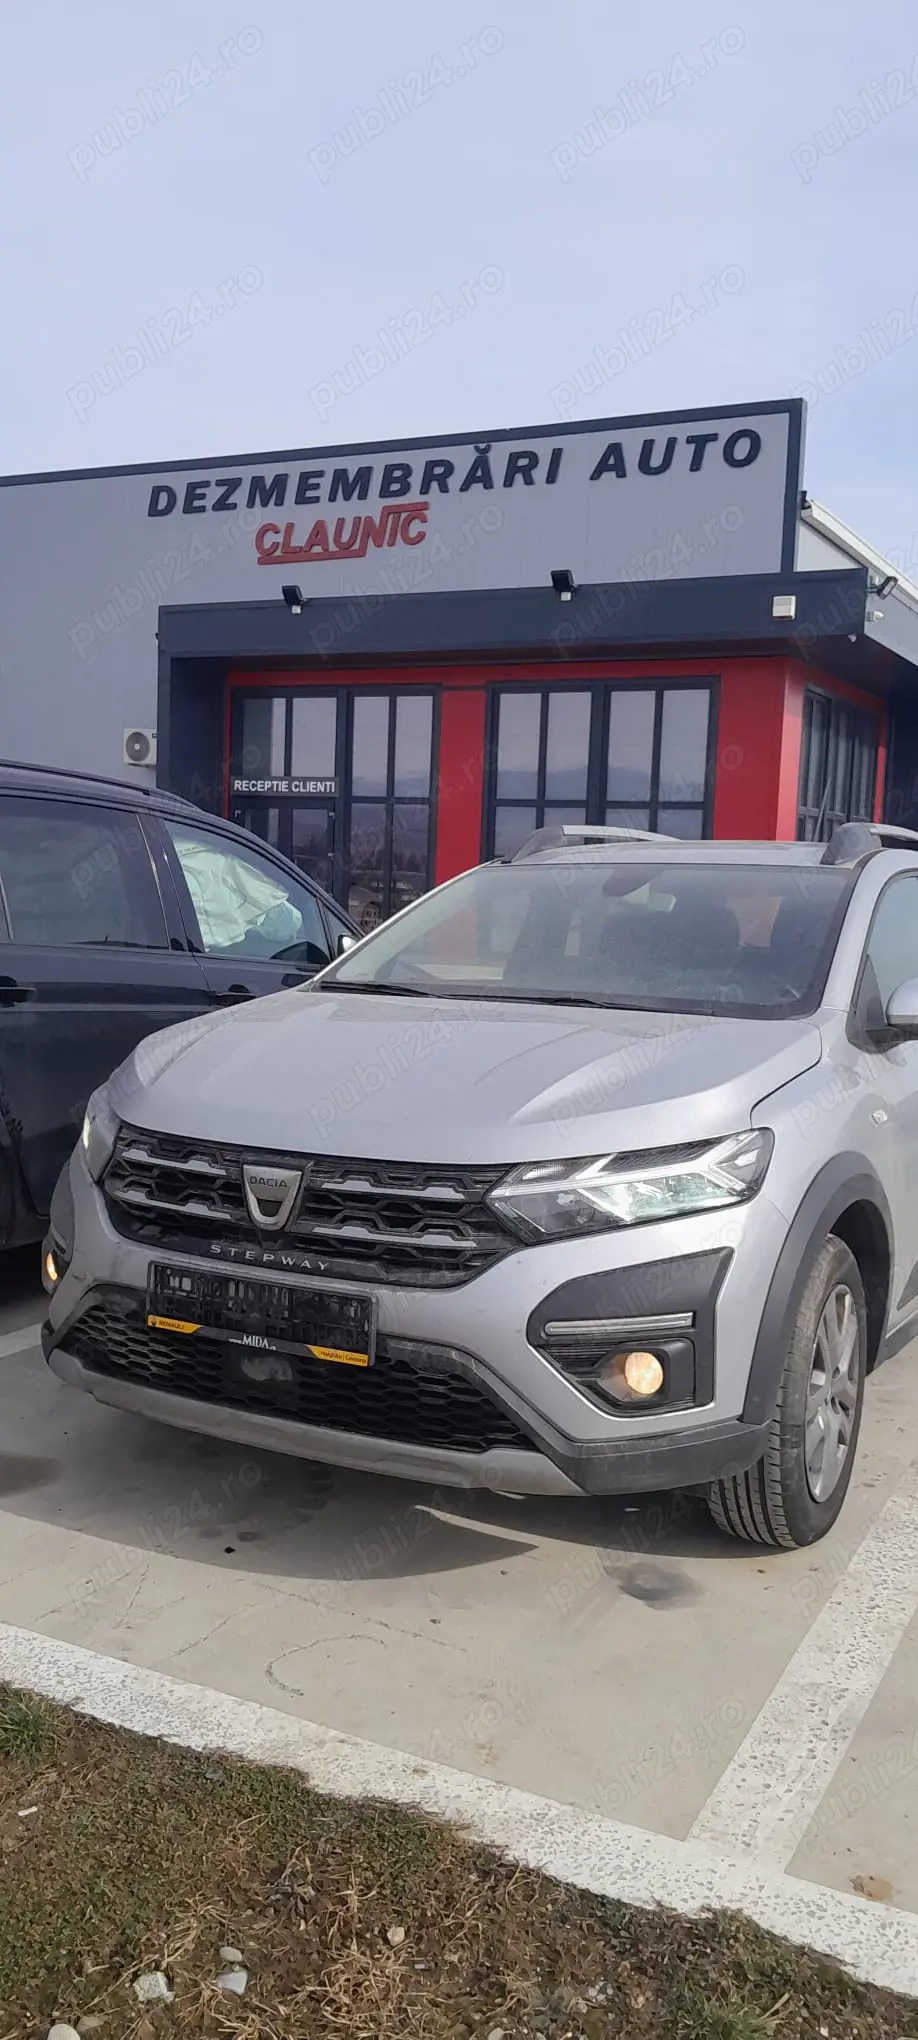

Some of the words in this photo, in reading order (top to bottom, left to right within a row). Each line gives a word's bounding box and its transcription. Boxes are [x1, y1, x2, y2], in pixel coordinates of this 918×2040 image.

[148, 443, 563, 517] DEZMEMBRĂRI
[589, 428, 762, 481] AUTO
[255, 501, 429, 565] CLAUNIC
[234, 780, 289, 791] RECEPTIE
[291, 781, 335, 793] CLIENTI
[249, 1176, 288, 1188] DACIA
[210, 1244, 329, 1271] STEPWAY
